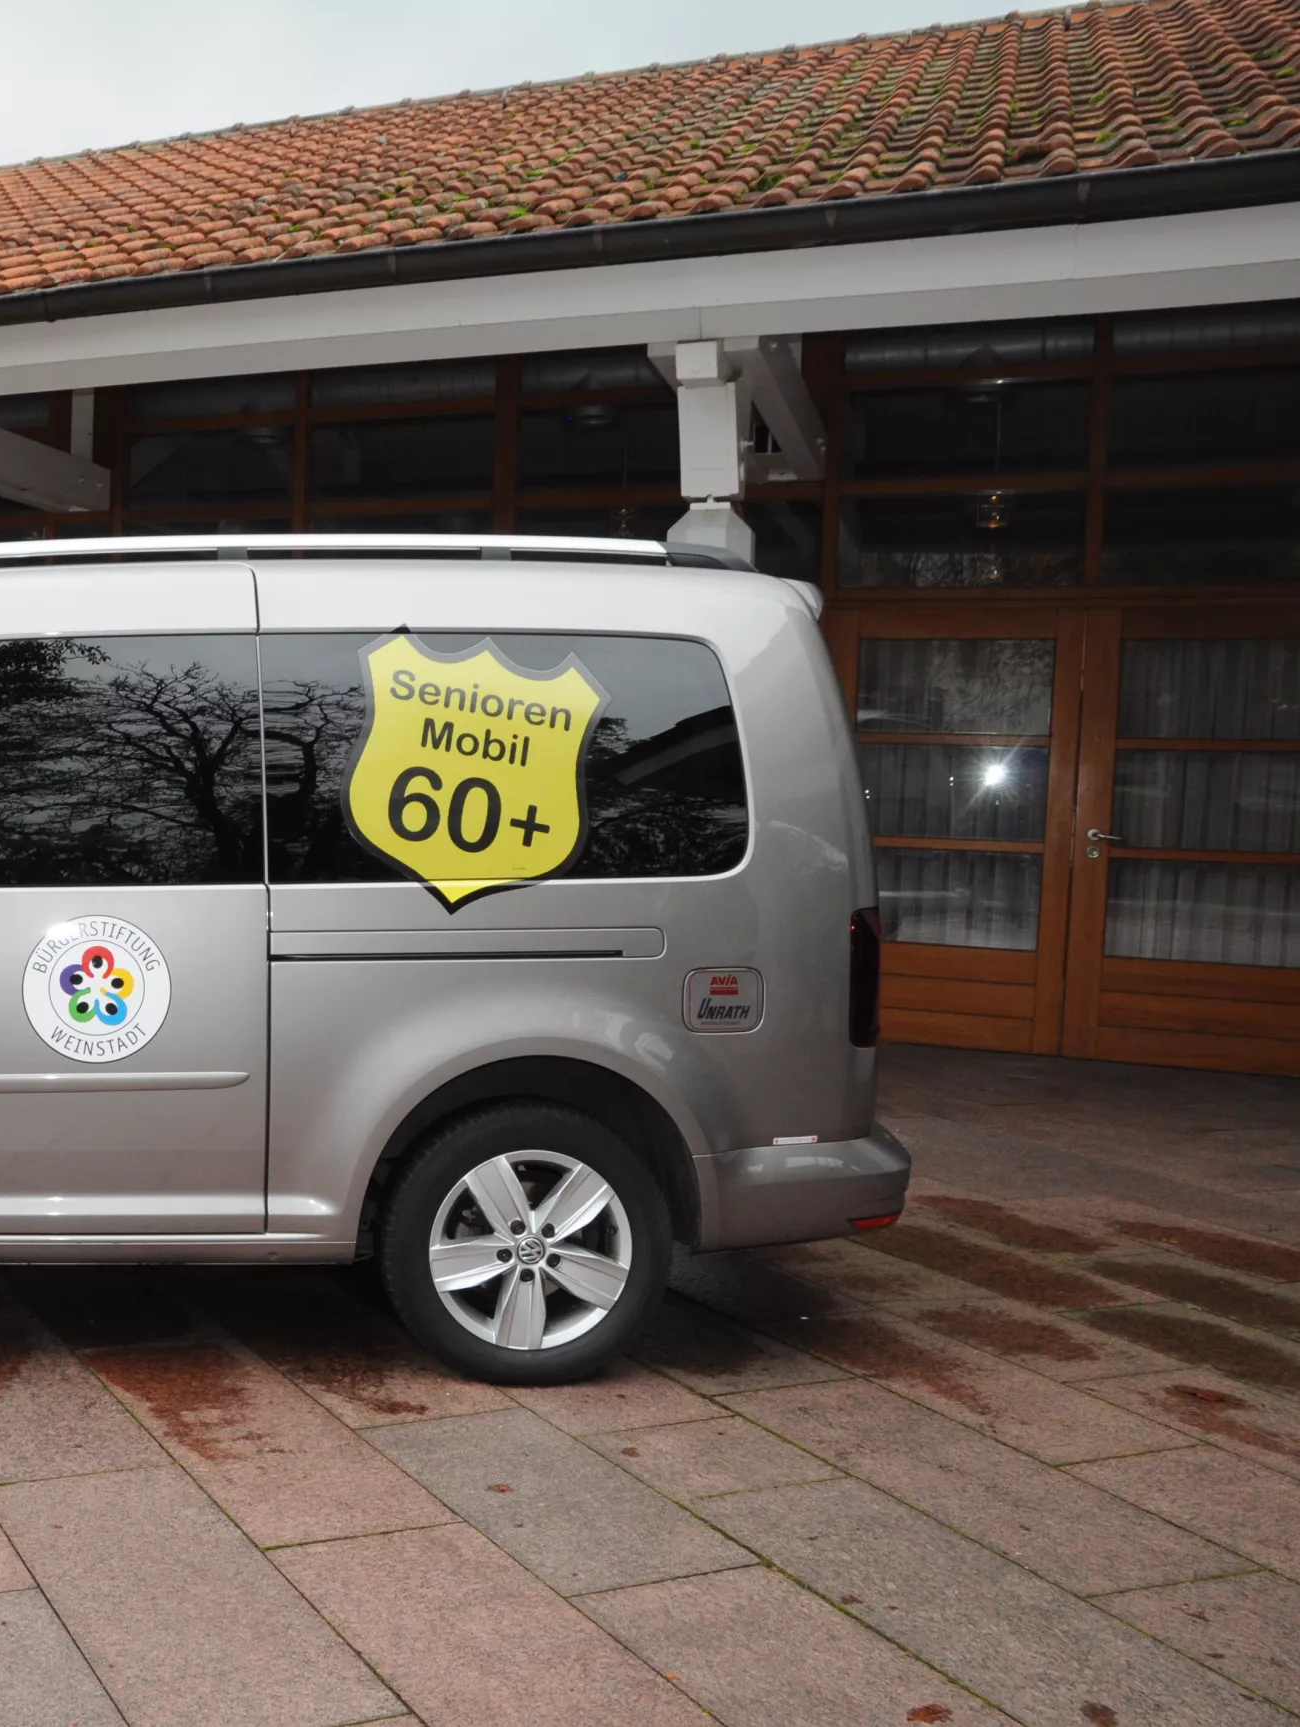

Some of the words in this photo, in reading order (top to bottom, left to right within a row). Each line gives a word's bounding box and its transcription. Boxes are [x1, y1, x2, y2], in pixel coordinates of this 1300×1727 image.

[390, 669, 572, 732] Senioren
[420, 717, 530, 767] Mobil
[388, 766, 550, 853] 60+
[710, 974, 738, 986] AVIA
[50, 1023, 147, 1057] WEINSTADT
